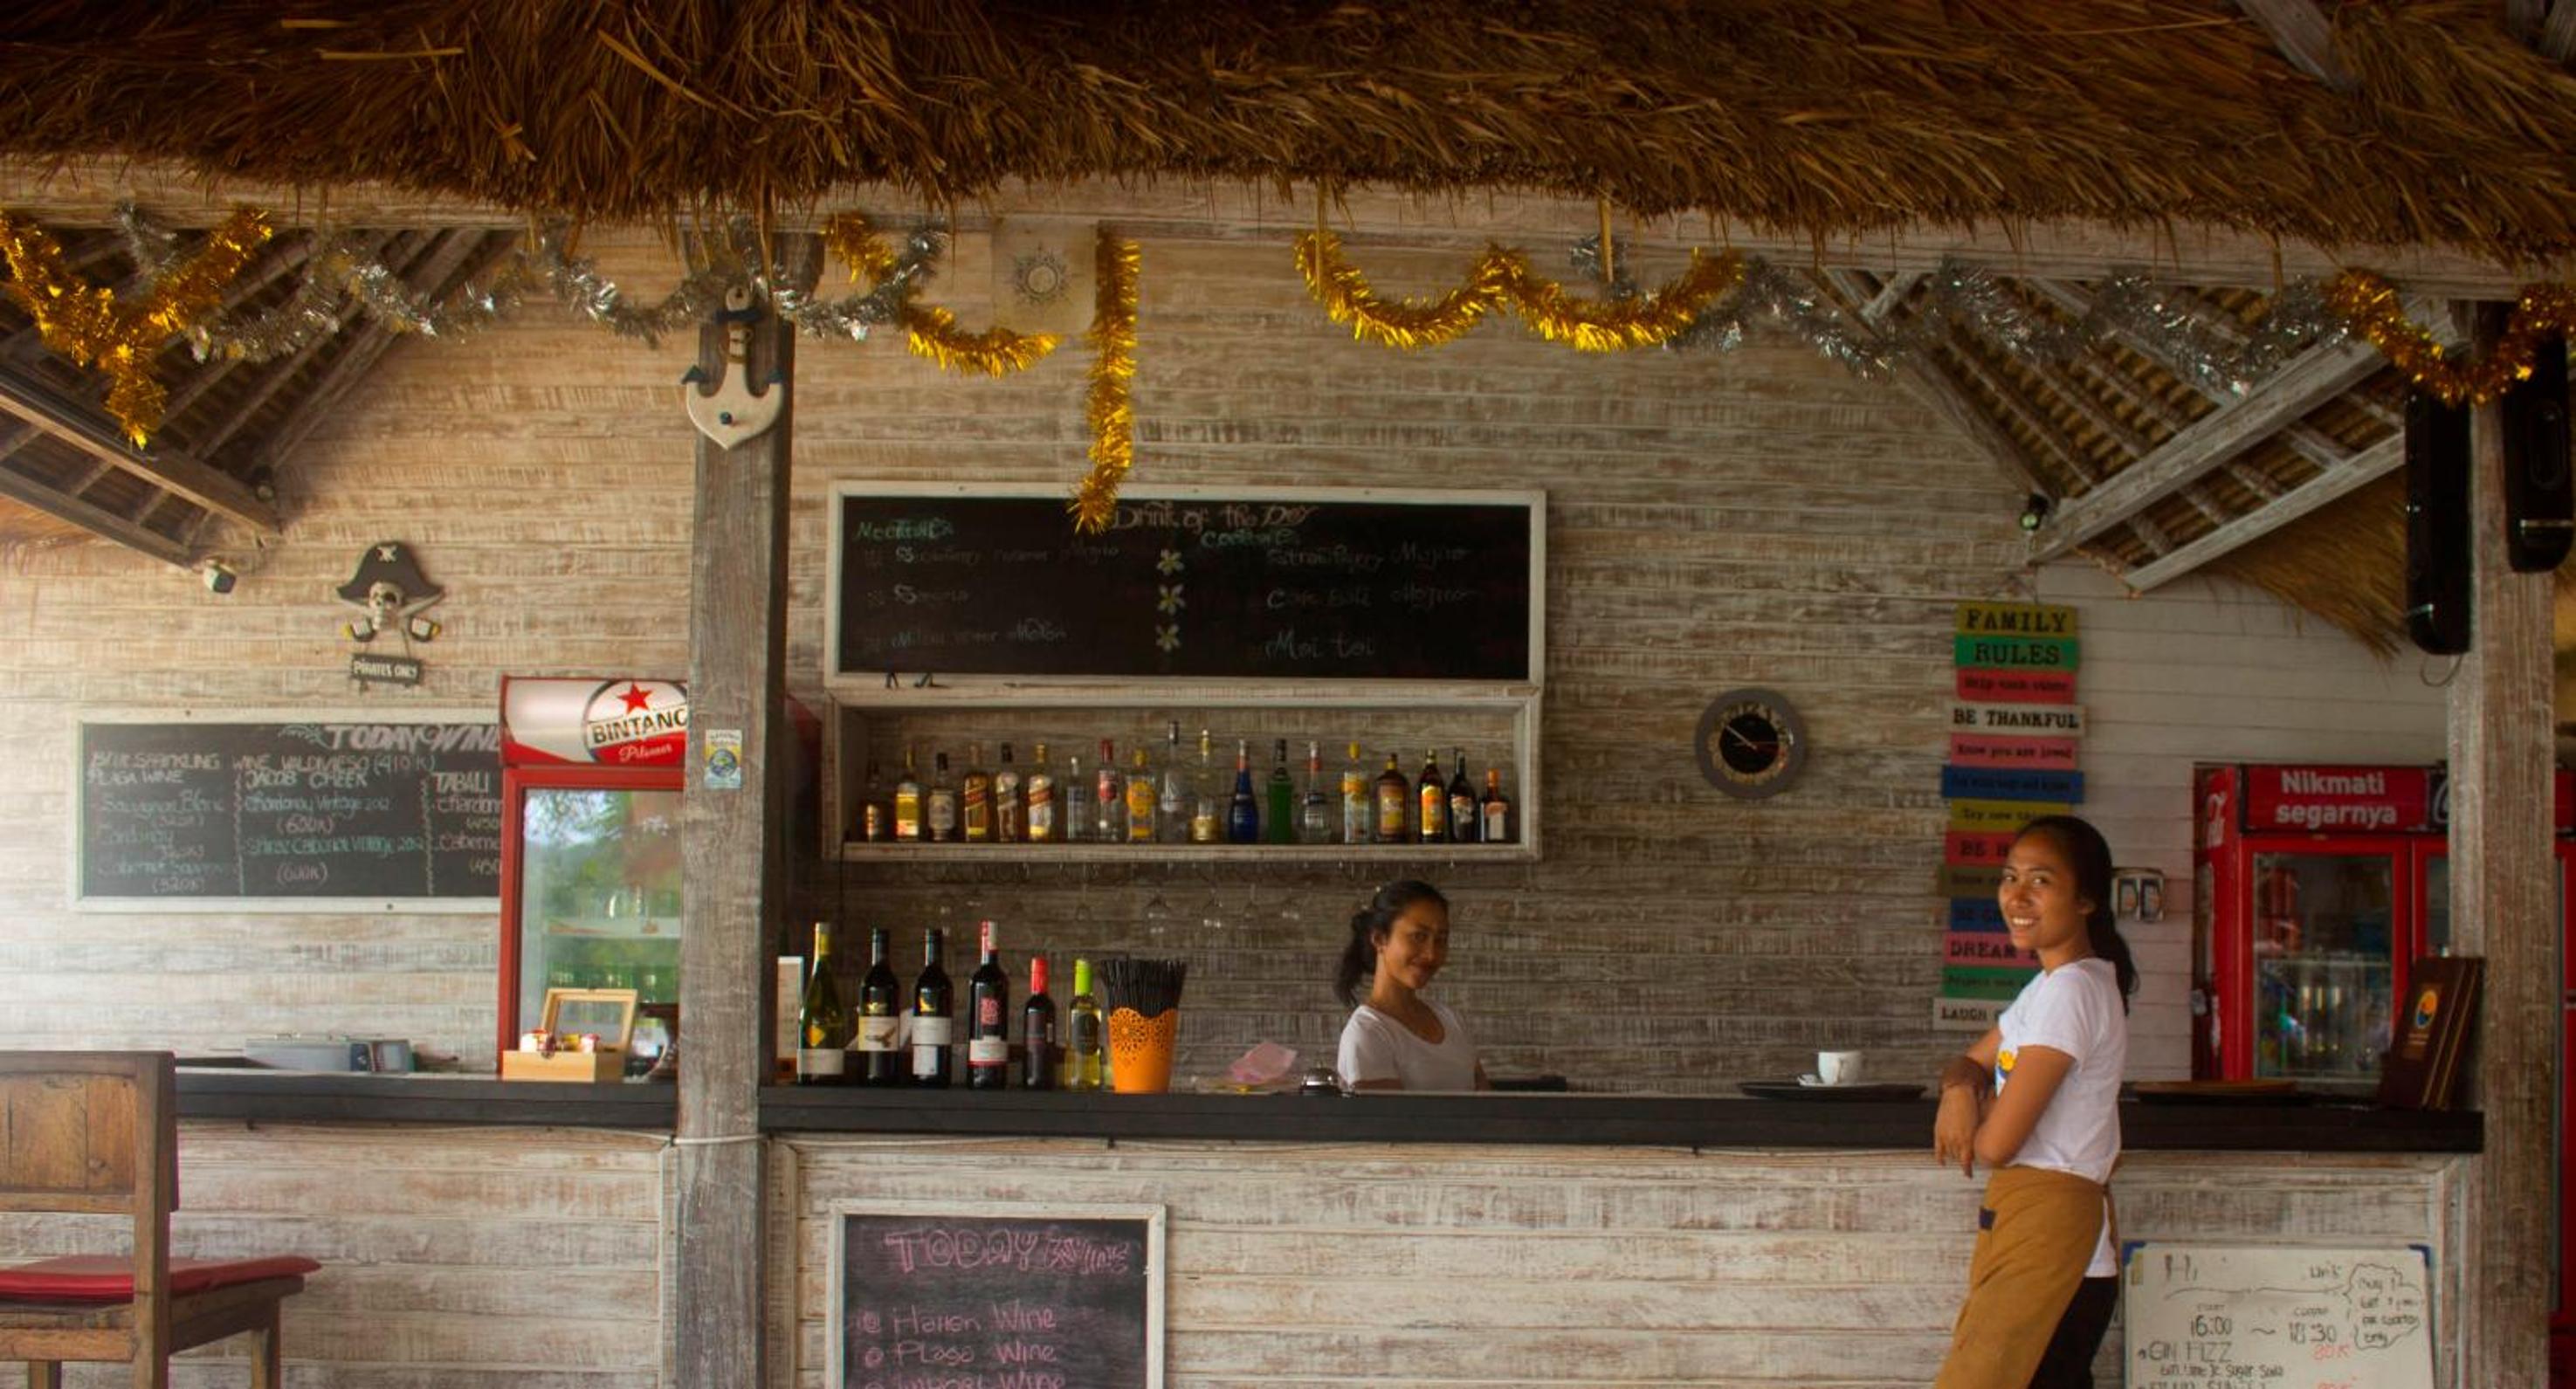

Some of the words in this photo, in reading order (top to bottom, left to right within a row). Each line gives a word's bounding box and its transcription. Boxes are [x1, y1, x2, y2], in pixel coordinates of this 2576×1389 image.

[1966, 609, 2068, 632] FAMILY
[1974, 643, 2061, 665] RULES
[1953, 709, 1977, 725] BE
[1987, 709, 2079, 729] THANKFUL
[2280, 770, 2386, 795] Nikmati
[2275, 804, 2397, 829] segarnya
[1950, 940, 2016, 959] DREAM
[1940, 1006, 1987, 1021] LAUGH
[884, 1227, 1040, 1274] TODAY
[989, 1297, 1057, 1332] Wine
[2190, 1315, 2234, 1337] 16:00
[994, 1340, 1058, 1372] Wine
